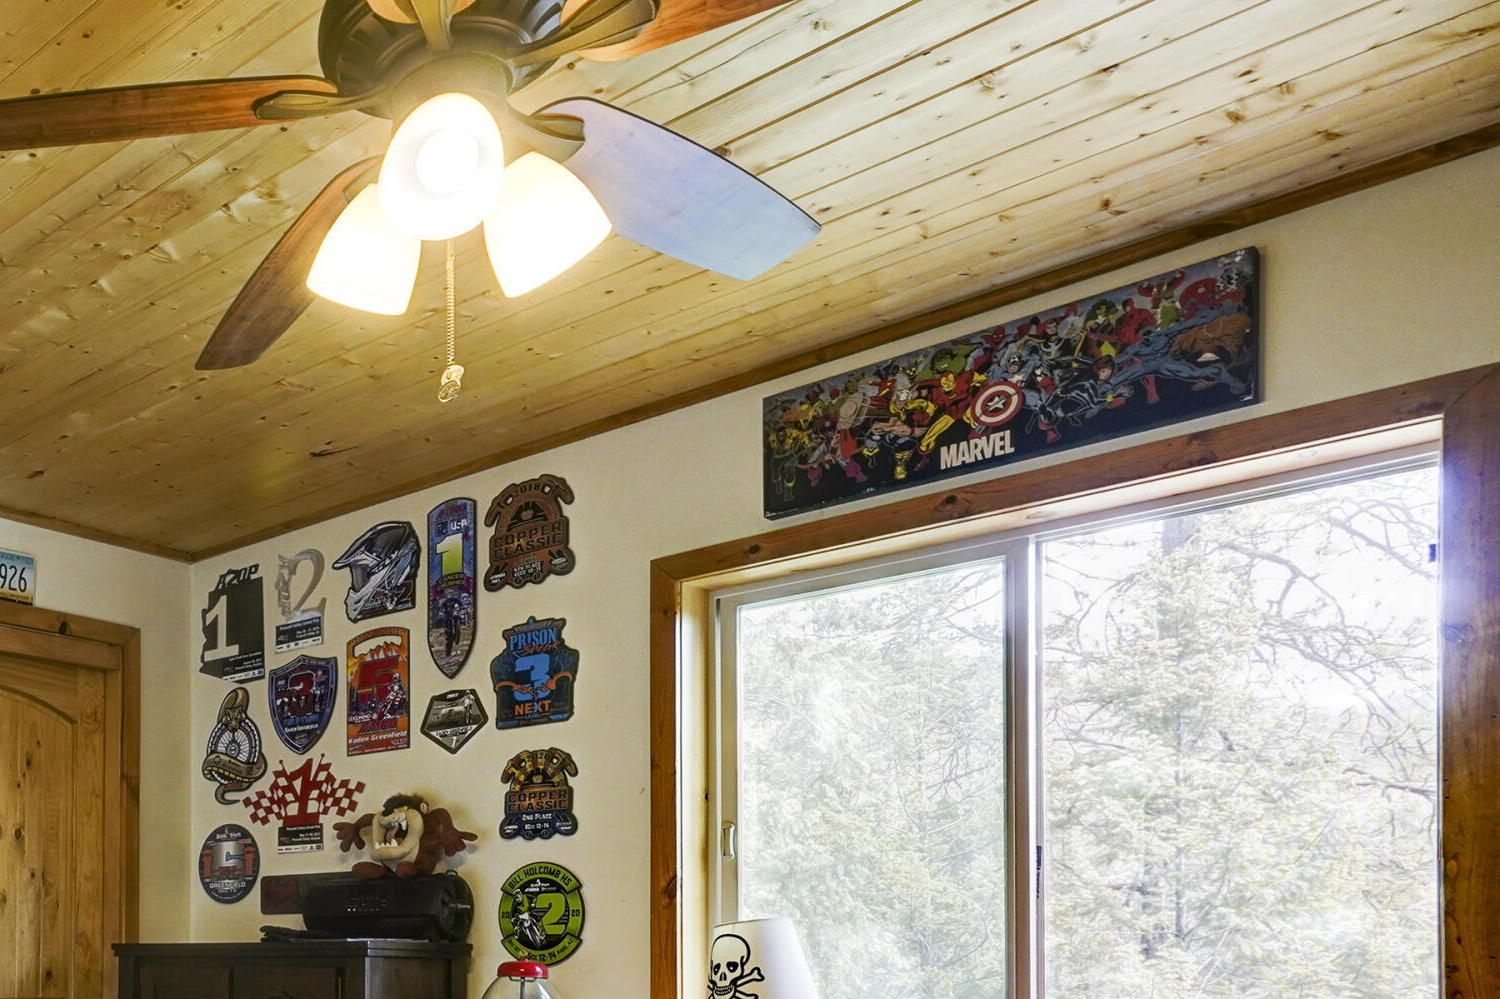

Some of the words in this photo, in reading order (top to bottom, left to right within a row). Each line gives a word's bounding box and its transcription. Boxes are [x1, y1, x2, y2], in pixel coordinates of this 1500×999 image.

[940, 429, 1016, 470] MARVEL
[494, 522, 562, 549] COPPER
[494, 532, 564, 560] CLASSIC
[436, 531, 464, 576] 1
[204, 595, 240, 662] 1
[509, 627, 558, 651] PRISON
[514, 700, 552, 716] NEXT
[371, 730, 408, 741] Greenfield
[508, 789, 567, 802] COPPER
[508, 799, 568, 812] CLASSIC
[508, 874, 524, 890] BILL
[523, 865, 562, 878] HOLCOMB
[562, 873, 573, 886] HS
[501, 911, 510, 919] 20
[535, 892, 566, 935] 2
[571, 909, 581, 917] 20
